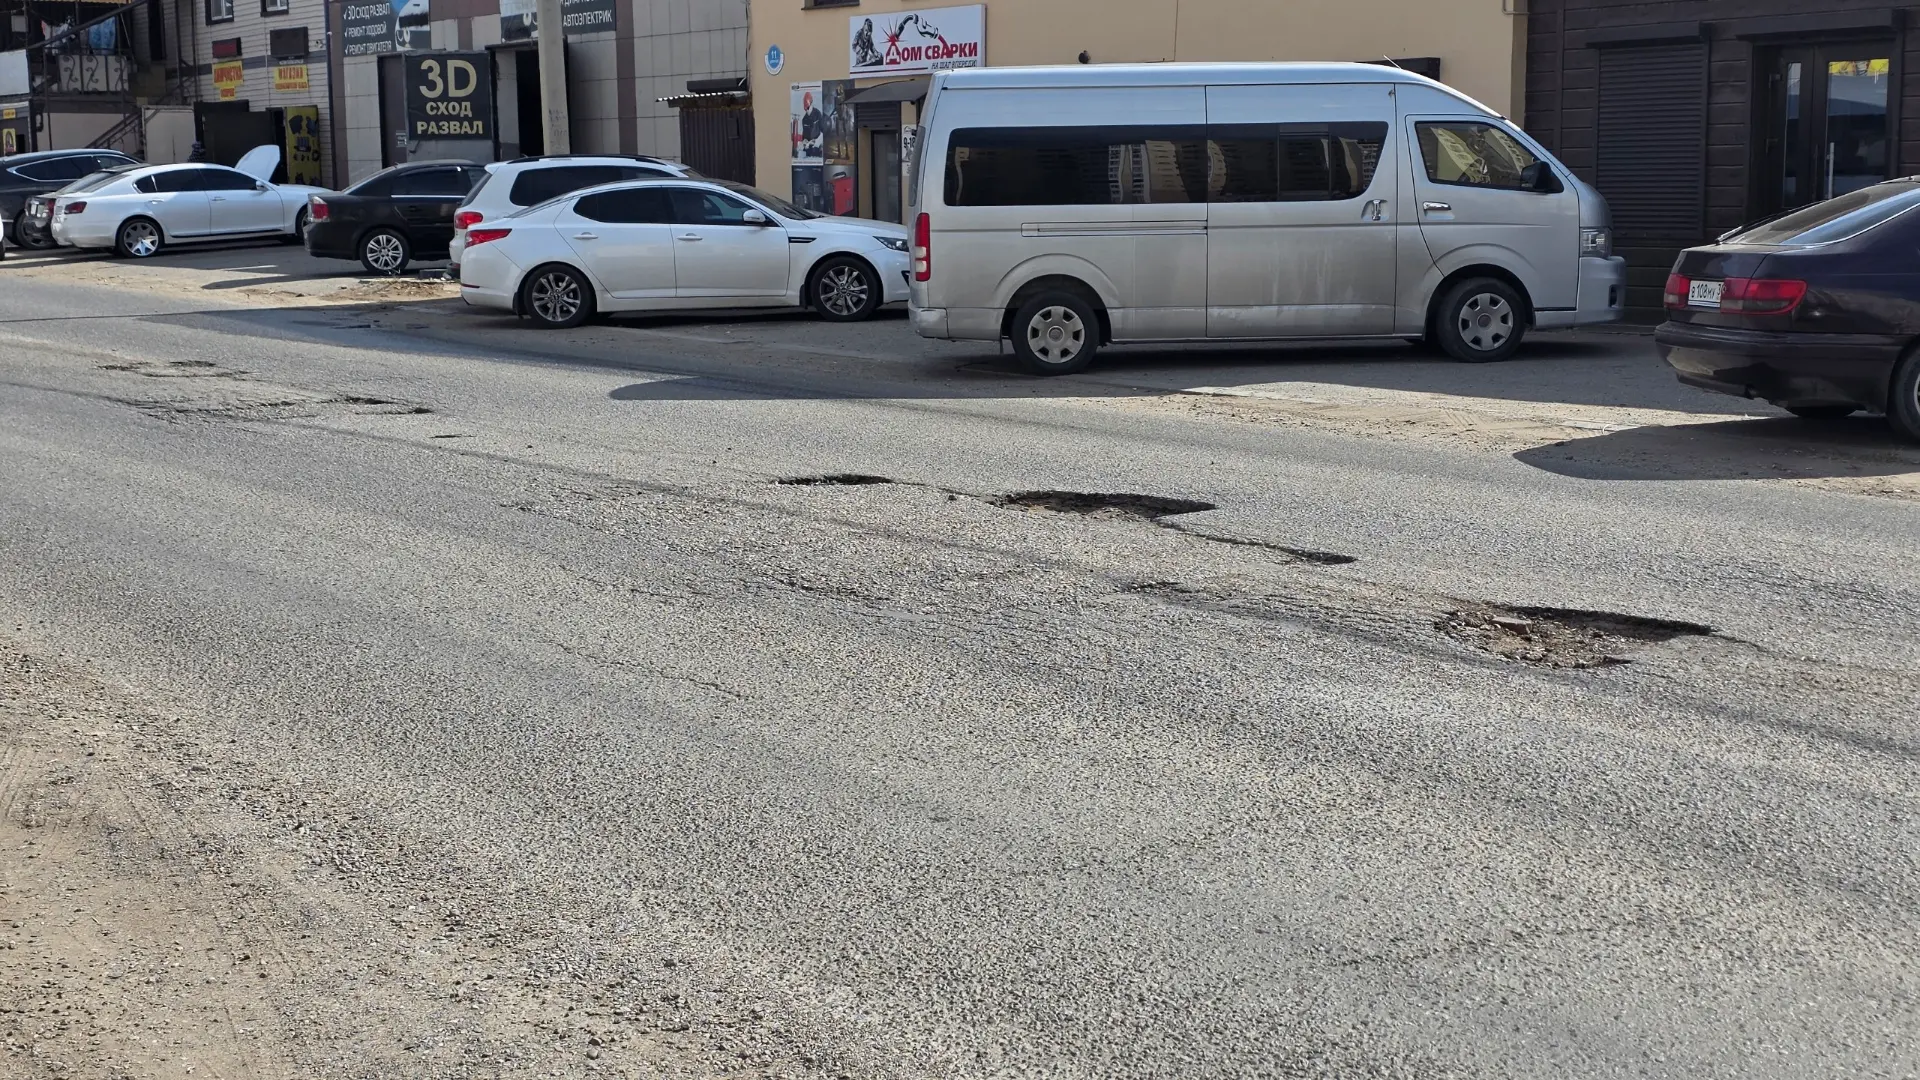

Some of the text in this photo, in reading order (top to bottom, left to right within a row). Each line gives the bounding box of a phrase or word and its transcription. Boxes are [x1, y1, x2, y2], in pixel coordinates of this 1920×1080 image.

[370, 3, 391, 17] РАЗВАЛ
[563, 10, 612, 27] АВТОЭЛЕКТРИК
[348, 26, 366, 37] РЕМОНТ
[349, 40, 392, 55] РЕМОНТ ДВИГАТЕЛЯ
[886, 42, 978, 65] ДОМ СВАРКИ
[931, 62, 939, 70] НА
[940, 61, 951, 70] ШАГ
[419, 59, 477, 98] 3D
[426, 101, 472, 117] СХОД
[417, 121, 483, 135] РАЗВАЛ
